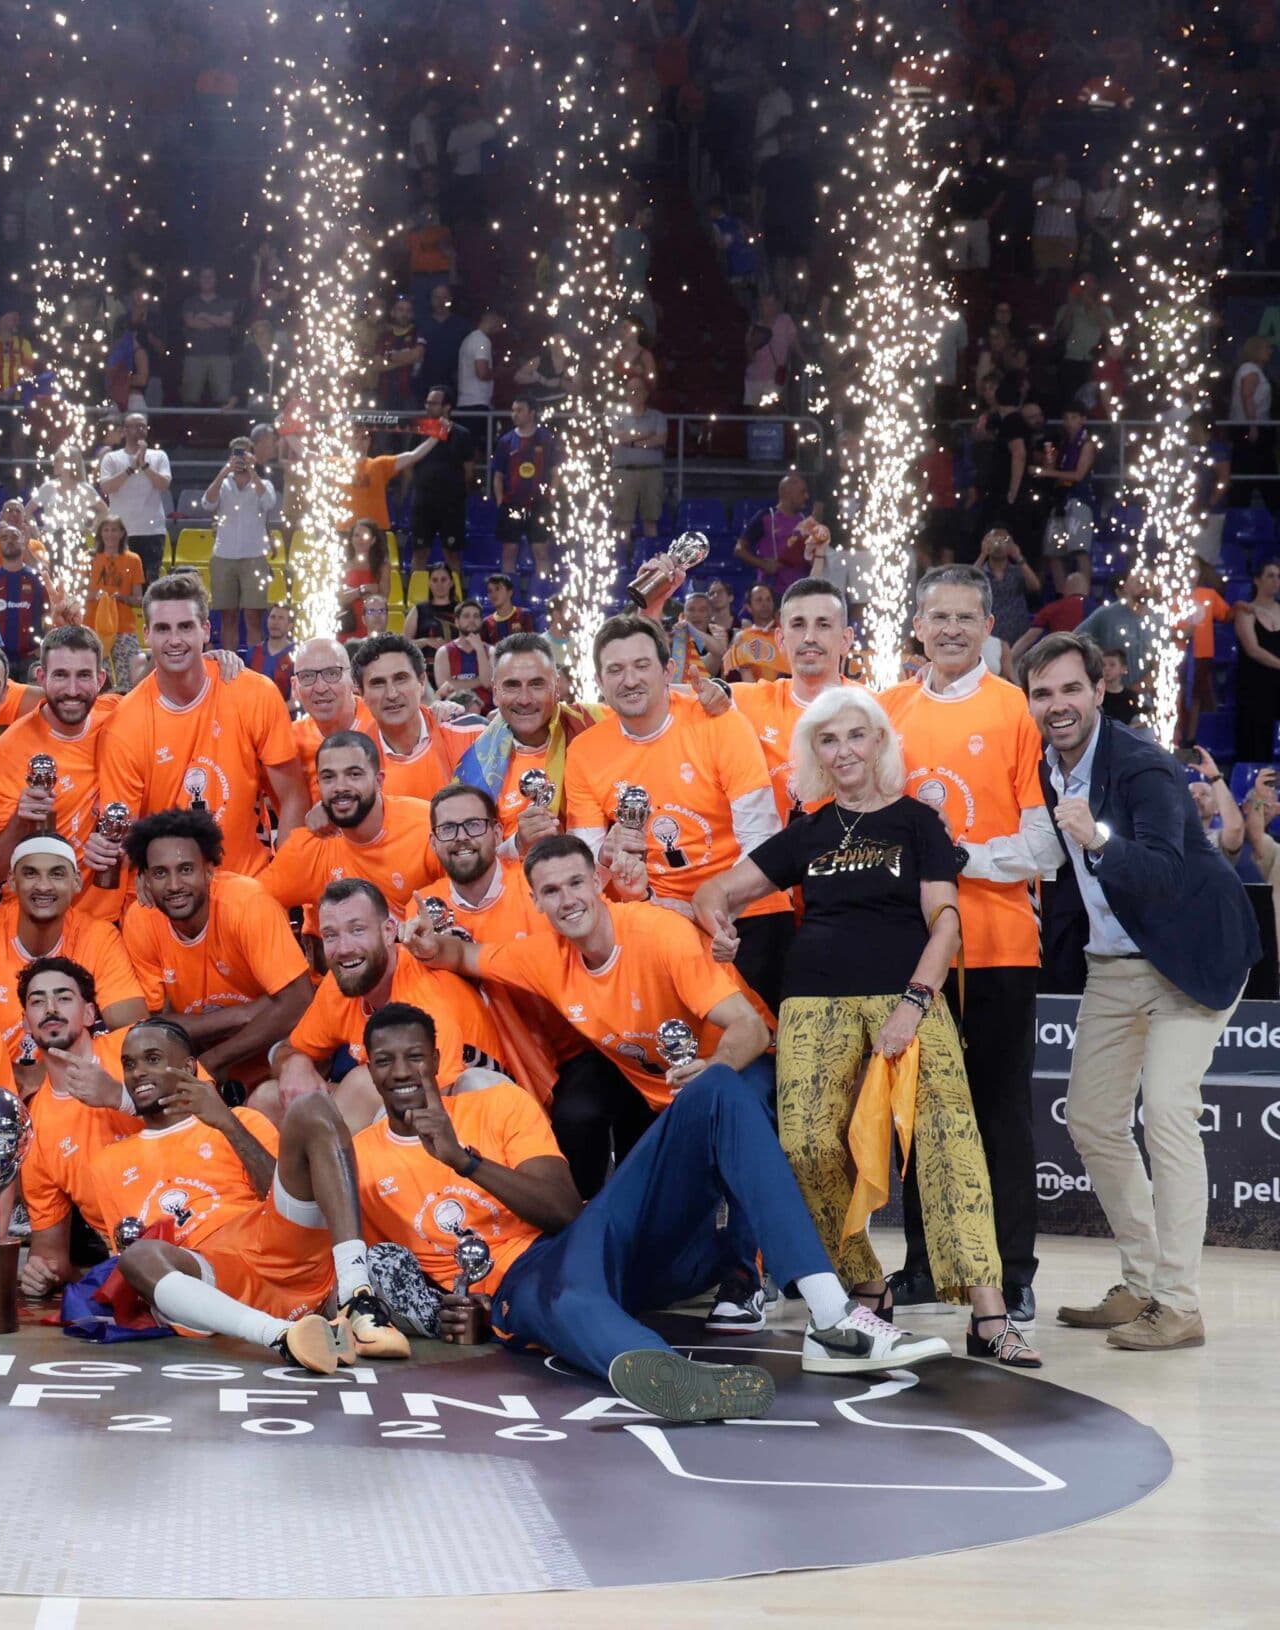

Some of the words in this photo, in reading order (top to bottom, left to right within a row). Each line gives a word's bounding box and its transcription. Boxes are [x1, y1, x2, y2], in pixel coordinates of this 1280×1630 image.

[936, 766, 975, 828] CAMPIONS
[1035, 1172, 1095, 1192] med
[108, 1414, 568, 1443] 2026
